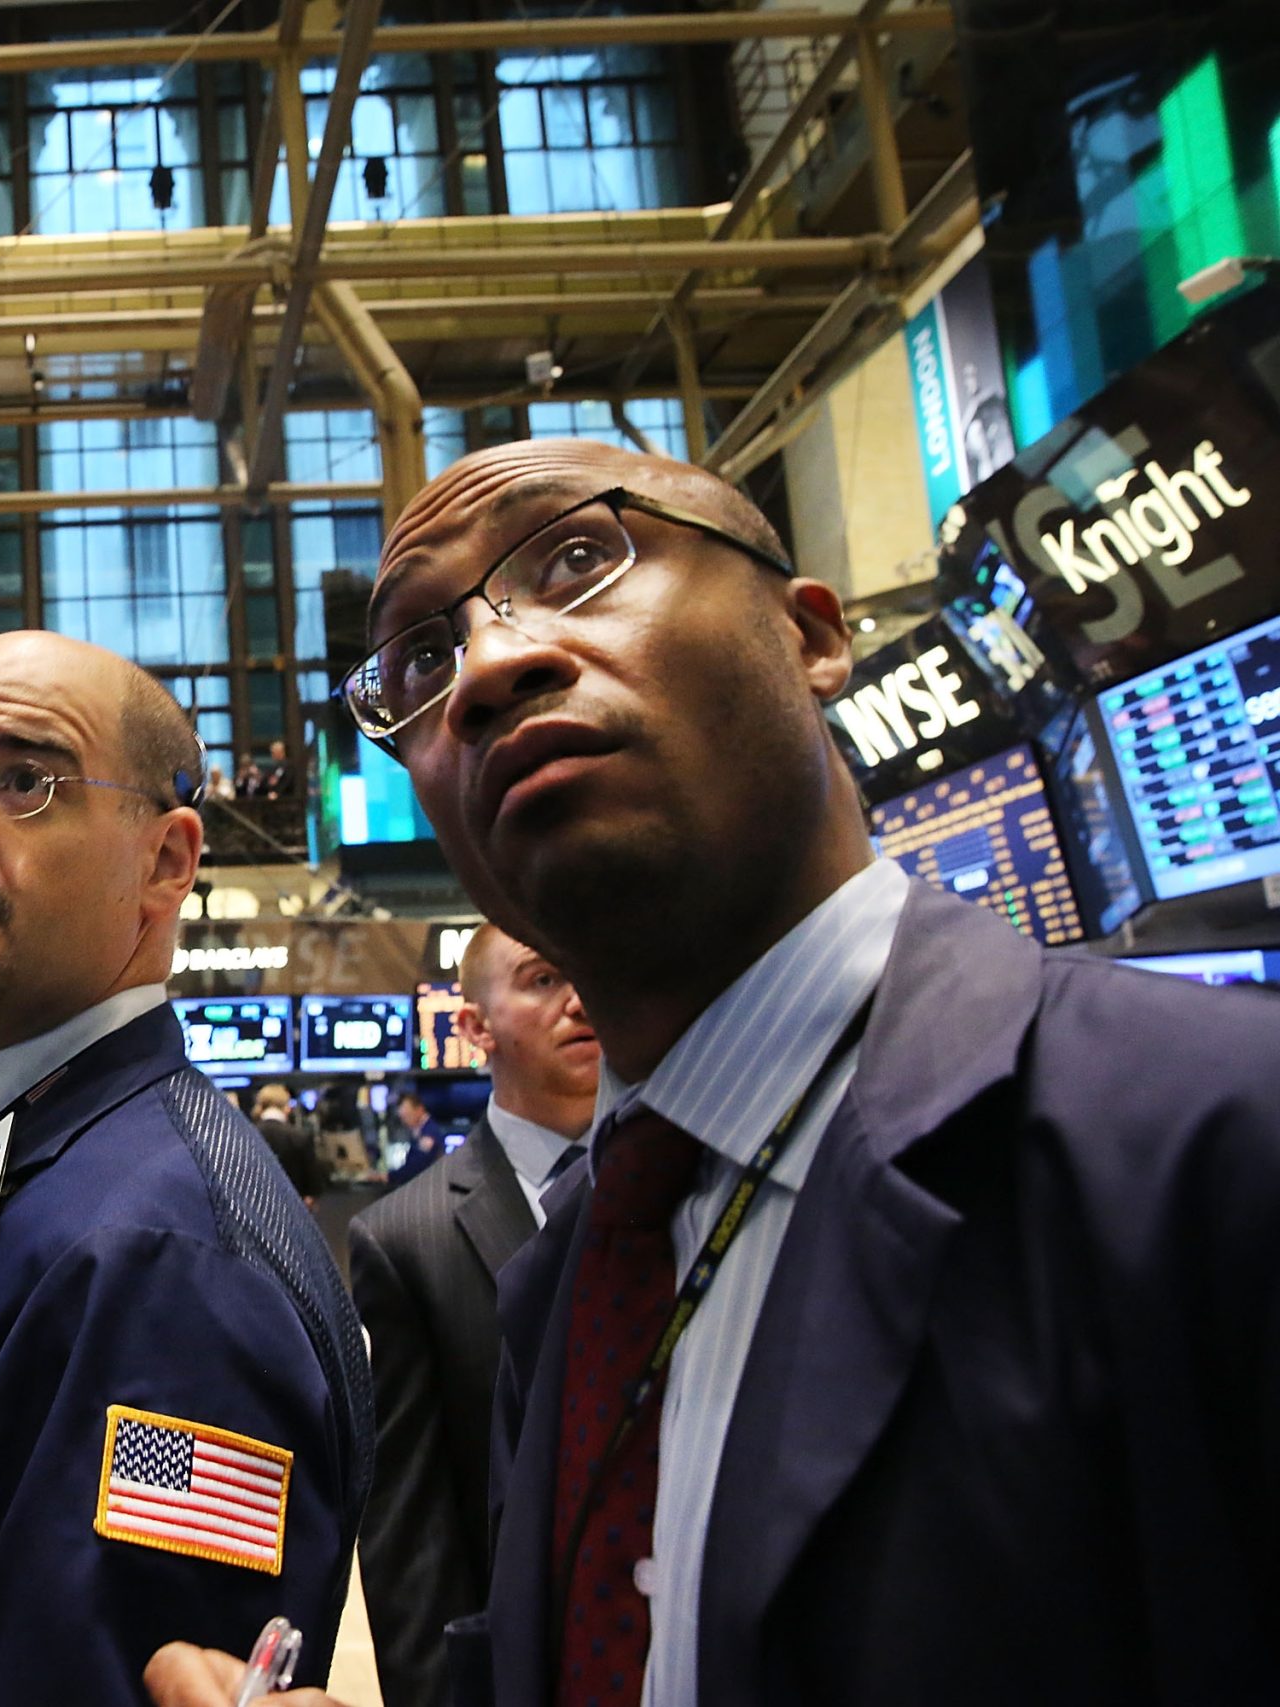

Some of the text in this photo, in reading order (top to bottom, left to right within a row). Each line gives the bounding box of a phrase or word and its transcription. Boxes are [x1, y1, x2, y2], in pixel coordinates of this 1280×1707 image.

[912, 327, 951, 477] LONDON
[1040, 439, 1252, 596] Knight
[835, 644, 981, 768] NYSE
